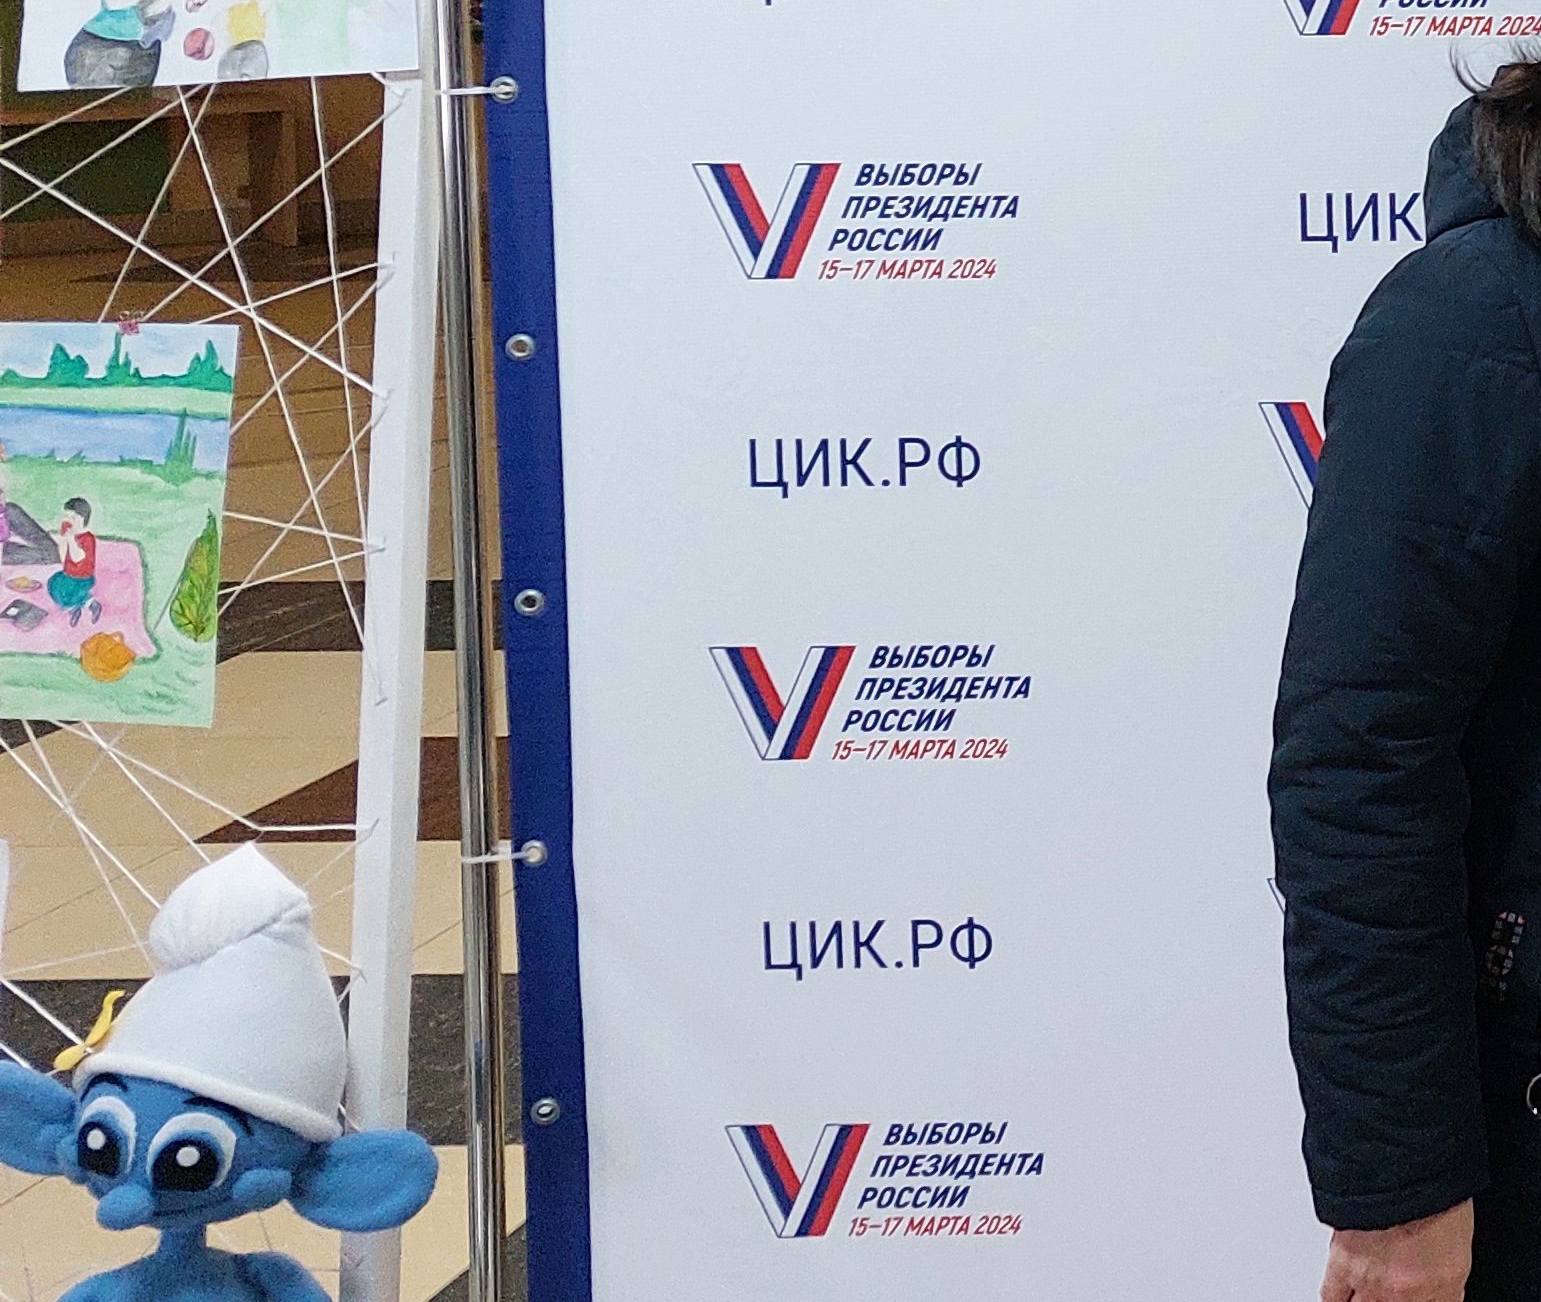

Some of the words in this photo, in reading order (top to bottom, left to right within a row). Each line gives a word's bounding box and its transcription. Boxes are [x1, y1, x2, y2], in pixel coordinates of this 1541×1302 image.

[1425, 15, 1492, 37] МАРТА
[854, 162, 983, 187] ВЫБОРЫ
[840, 195, 1020, 223] ПРЕЗИДЕНТА
[1299, 192, 1424, 254] ЦИК
[827, 227, 945, 252] РОССИИ
[875, 259, 945, 280] МАРТА
[947, 258, 997, 279] 2024
[749, 435, 981, 499] ЦИК.РФ
[868, 644, 996, 669] ВЫБОРЫ
[854, 675, 1032, 704] ПРЕЗИДЕНТА
[841, 708, 957, 733] РОССИИ
[887, 738, 957, 760] МАРТА
[958, 738, 1009, 759] 2024
[763, 916, 993, 982] ЦИК.РФ
[882, 1121, 1009, 1147] ВЫБОРЫ
[869, 1152, 1045, 1181] ПРЕЗИДЕНТА
[856, 1185, 971, 1210] РОССИИ
[903, 1215, 971, 1237] МАРТА
[973, 1214, 1022, 1235] 2024
